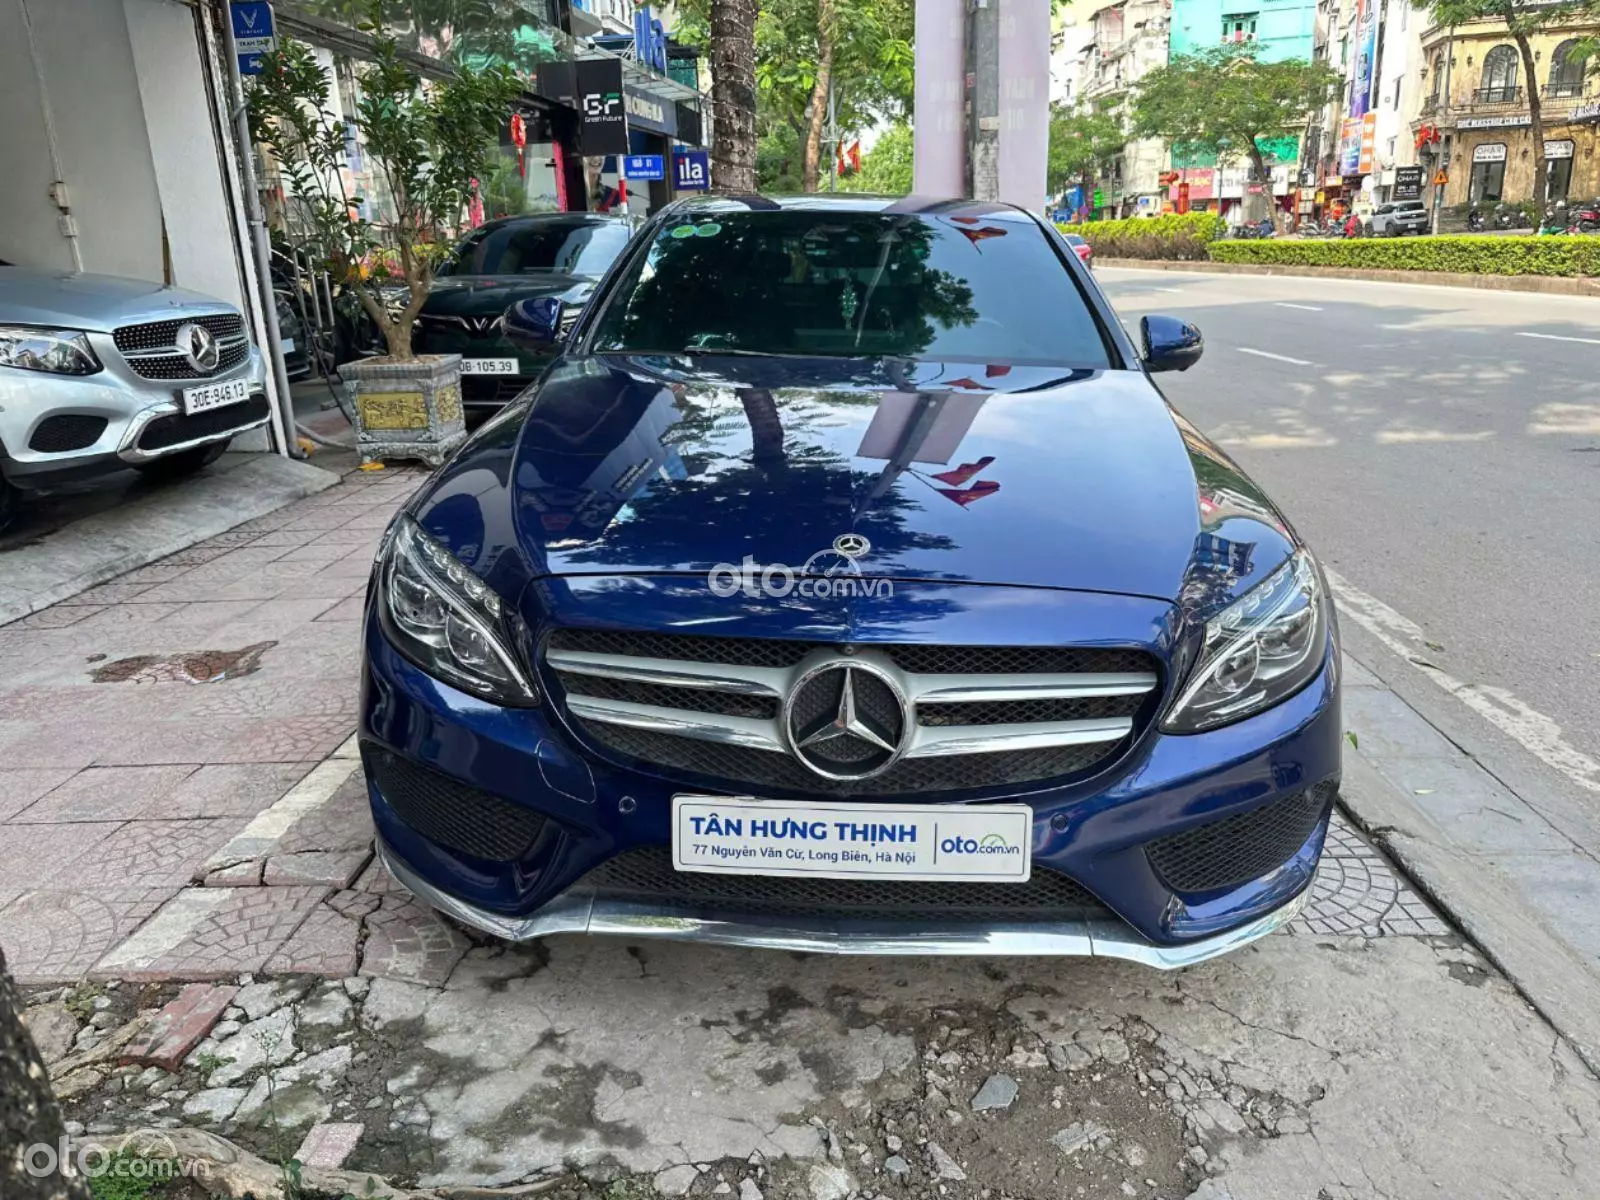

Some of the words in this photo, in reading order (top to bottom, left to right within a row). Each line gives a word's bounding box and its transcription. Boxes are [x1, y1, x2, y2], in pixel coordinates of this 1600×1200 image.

[678, 157, 703, 179] ila
[191, 383, 245, 408] 30E-946.13
[690, 812, 742, 837] TÂN
[751, 817, 827, 841] HƯNG
[834, 822, 917, 848] THỊNH
[693, 844, 708, 855] 77
[759, 846, 782, 859] Văn
[808, 850, 838, 863] Long
[841, 850, 872, 863] Biên,
[875, 851, 891, 863] Hà
[895, 851, 916, 865] Nội
[940, 835, 1020, 855] oto.com.vn
